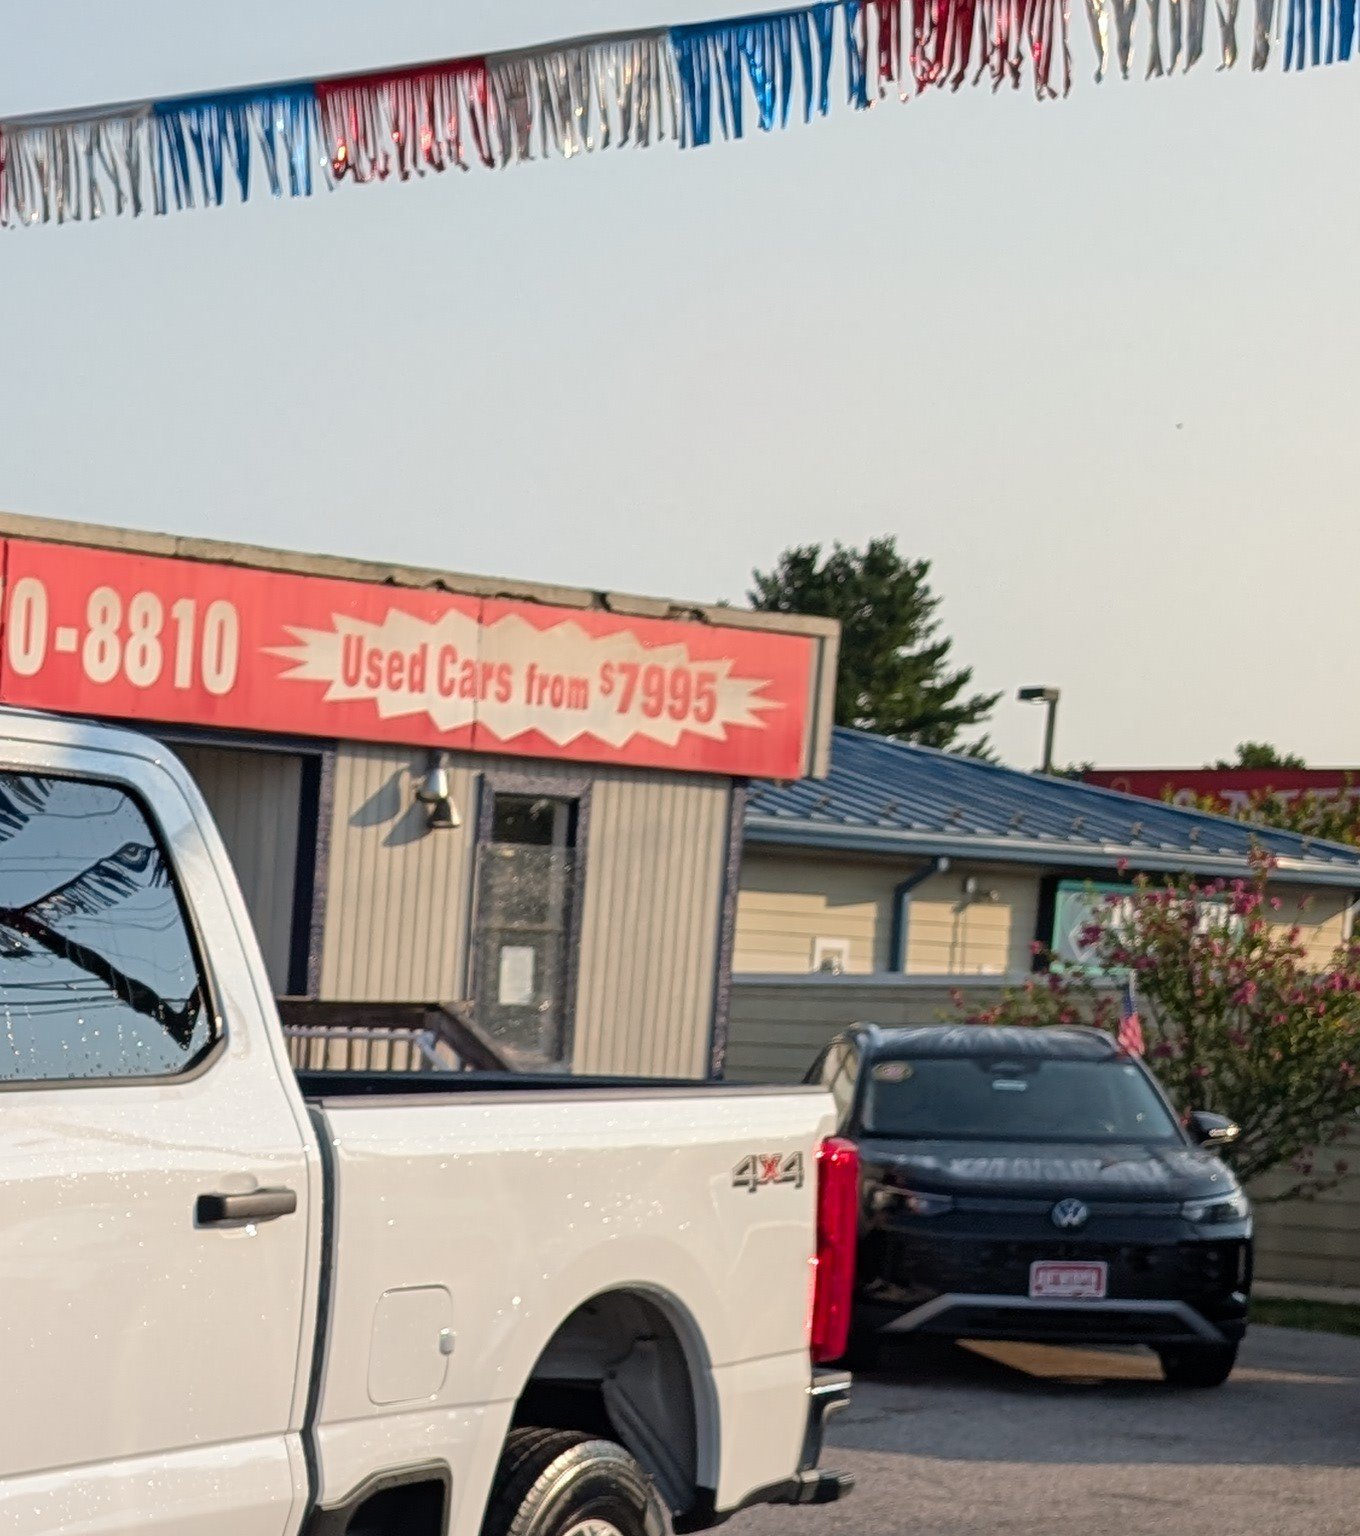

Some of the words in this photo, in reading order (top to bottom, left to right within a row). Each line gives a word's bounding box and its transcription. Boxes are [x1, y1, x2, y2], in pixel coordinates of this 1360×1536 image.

[342, 634, 427, 693] Used
[437, 644, 513, 703] Cars
[524, 662, 589, 711] from
[598, 657, 719, 723] $7995
